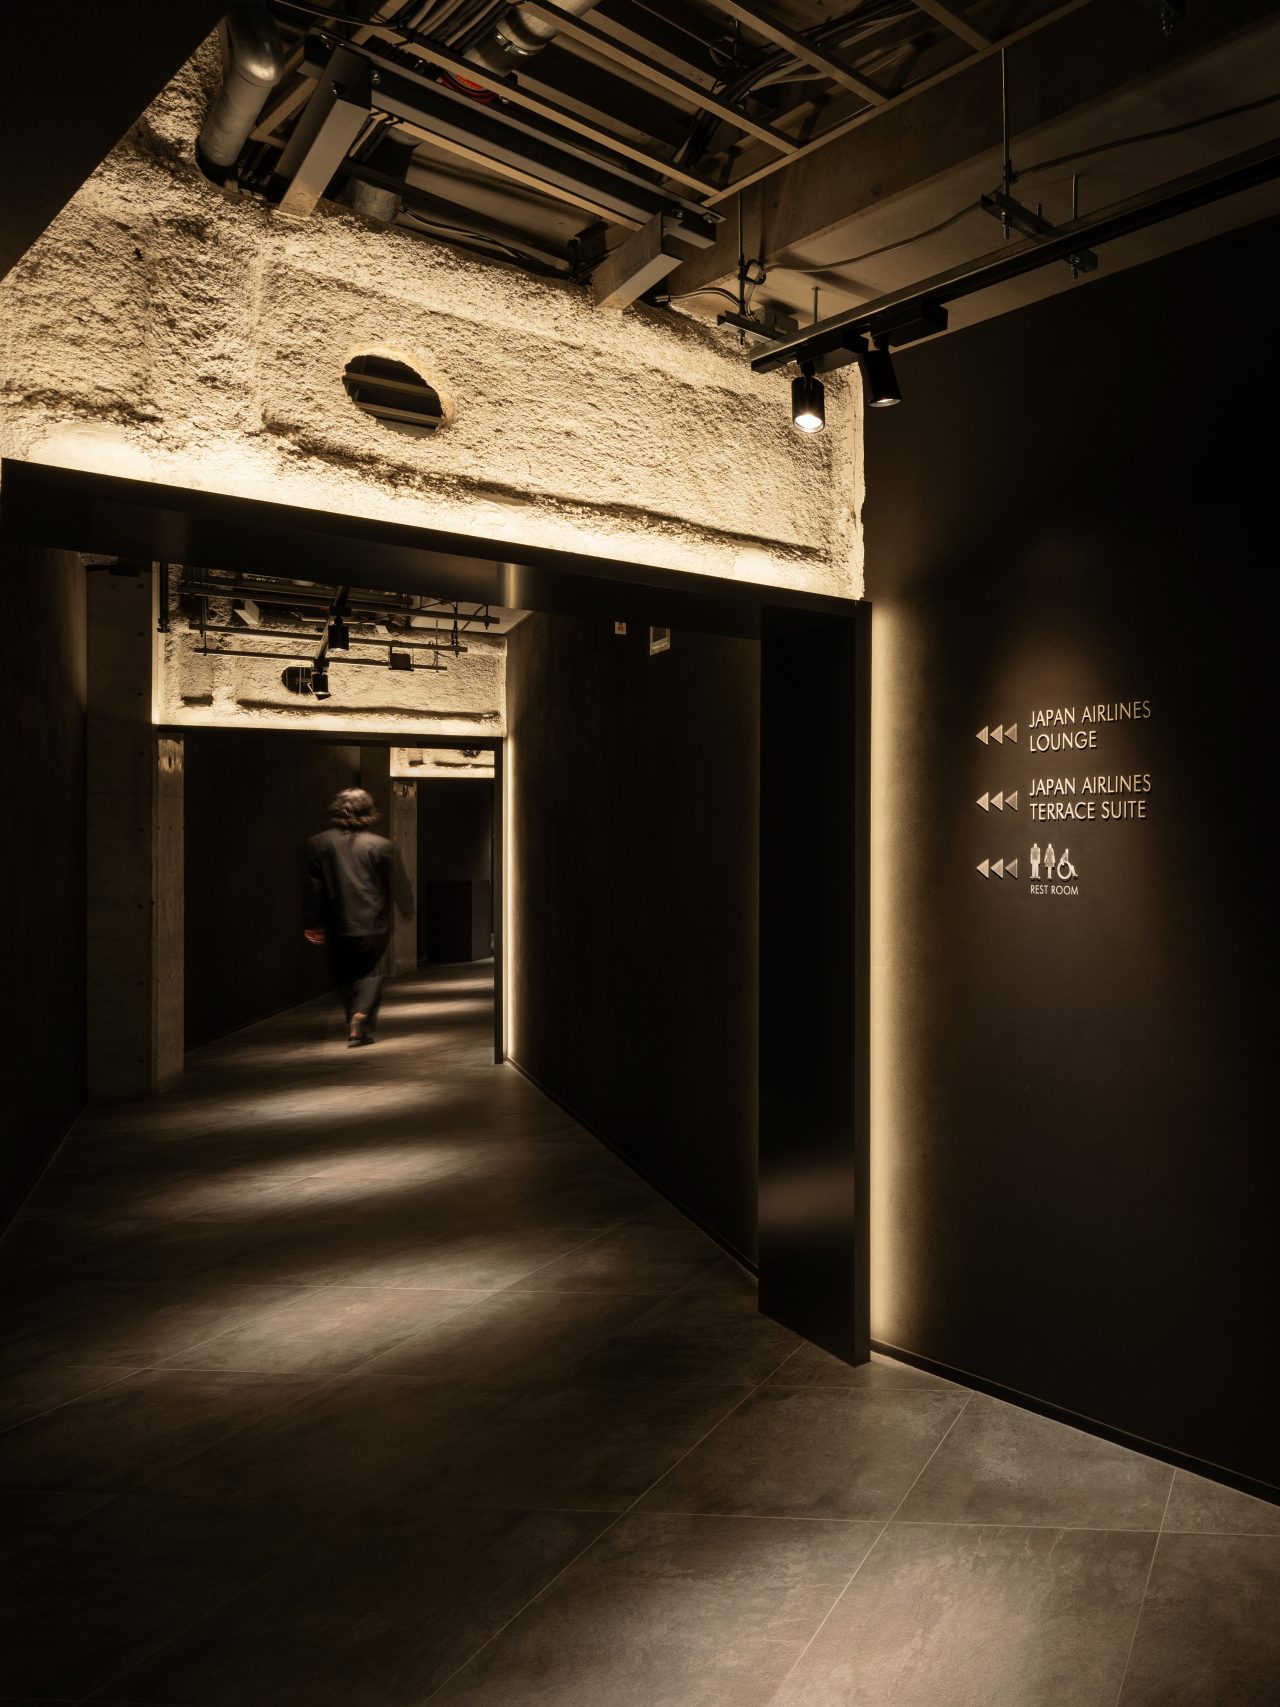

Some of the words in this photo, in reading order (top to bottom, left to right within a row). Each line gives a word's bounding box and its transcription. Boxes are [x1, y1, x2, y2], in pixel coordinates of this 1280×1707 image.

[1029, 707, 1076, 729] JAPAN
[1081, 700, 1152, 723] AIRLINES
[1029, 730, 1098, 752] LOUNGE
[1029, 777, 1076, 797] JAPAN
[1081, 774, 1152, 795] AIRLINES
[1030, 802, 1096, 821] TERRACE
[1101, 800, 1147, 820] SUITE
[1030, 884, 1049, 895] REST
[1051, 885, 1079, 896] ROOM
